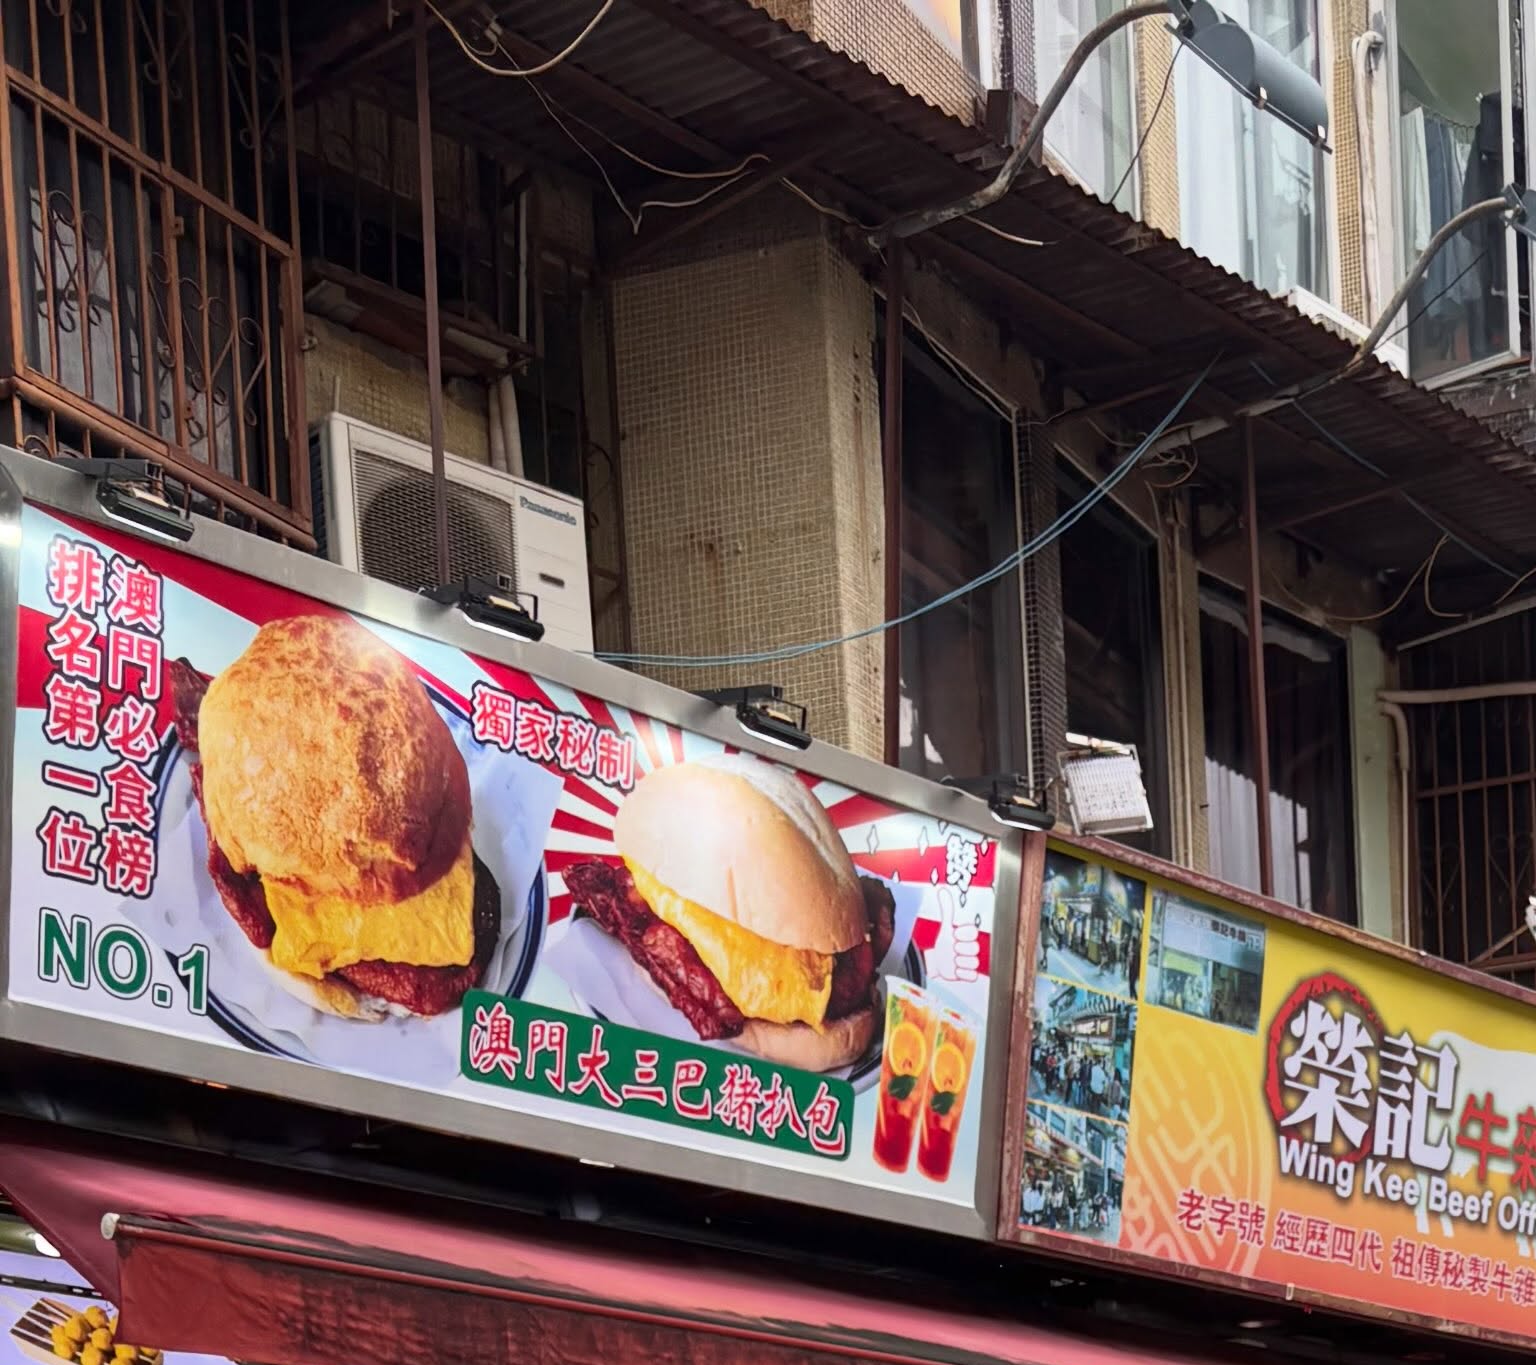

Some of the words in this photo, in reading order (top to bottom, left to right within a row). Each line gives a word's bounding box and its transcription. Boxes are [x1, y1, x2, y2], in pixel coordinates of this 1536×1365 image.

[37, 536, 104, 883] 排名第一位
[102, 556, 163, 898] 澳門必食榜
[470, 683, 637, 791] 獨家秘制
[38, 908, 210, 1016] NO.1
[1177, 1188, 1266, 1247] 老字號
[1279, 1135, 1355, 1198] Wing
[1364, 1159, 1421, 1206] Kee
[1429, 1176, 1493, 1224] Beef
